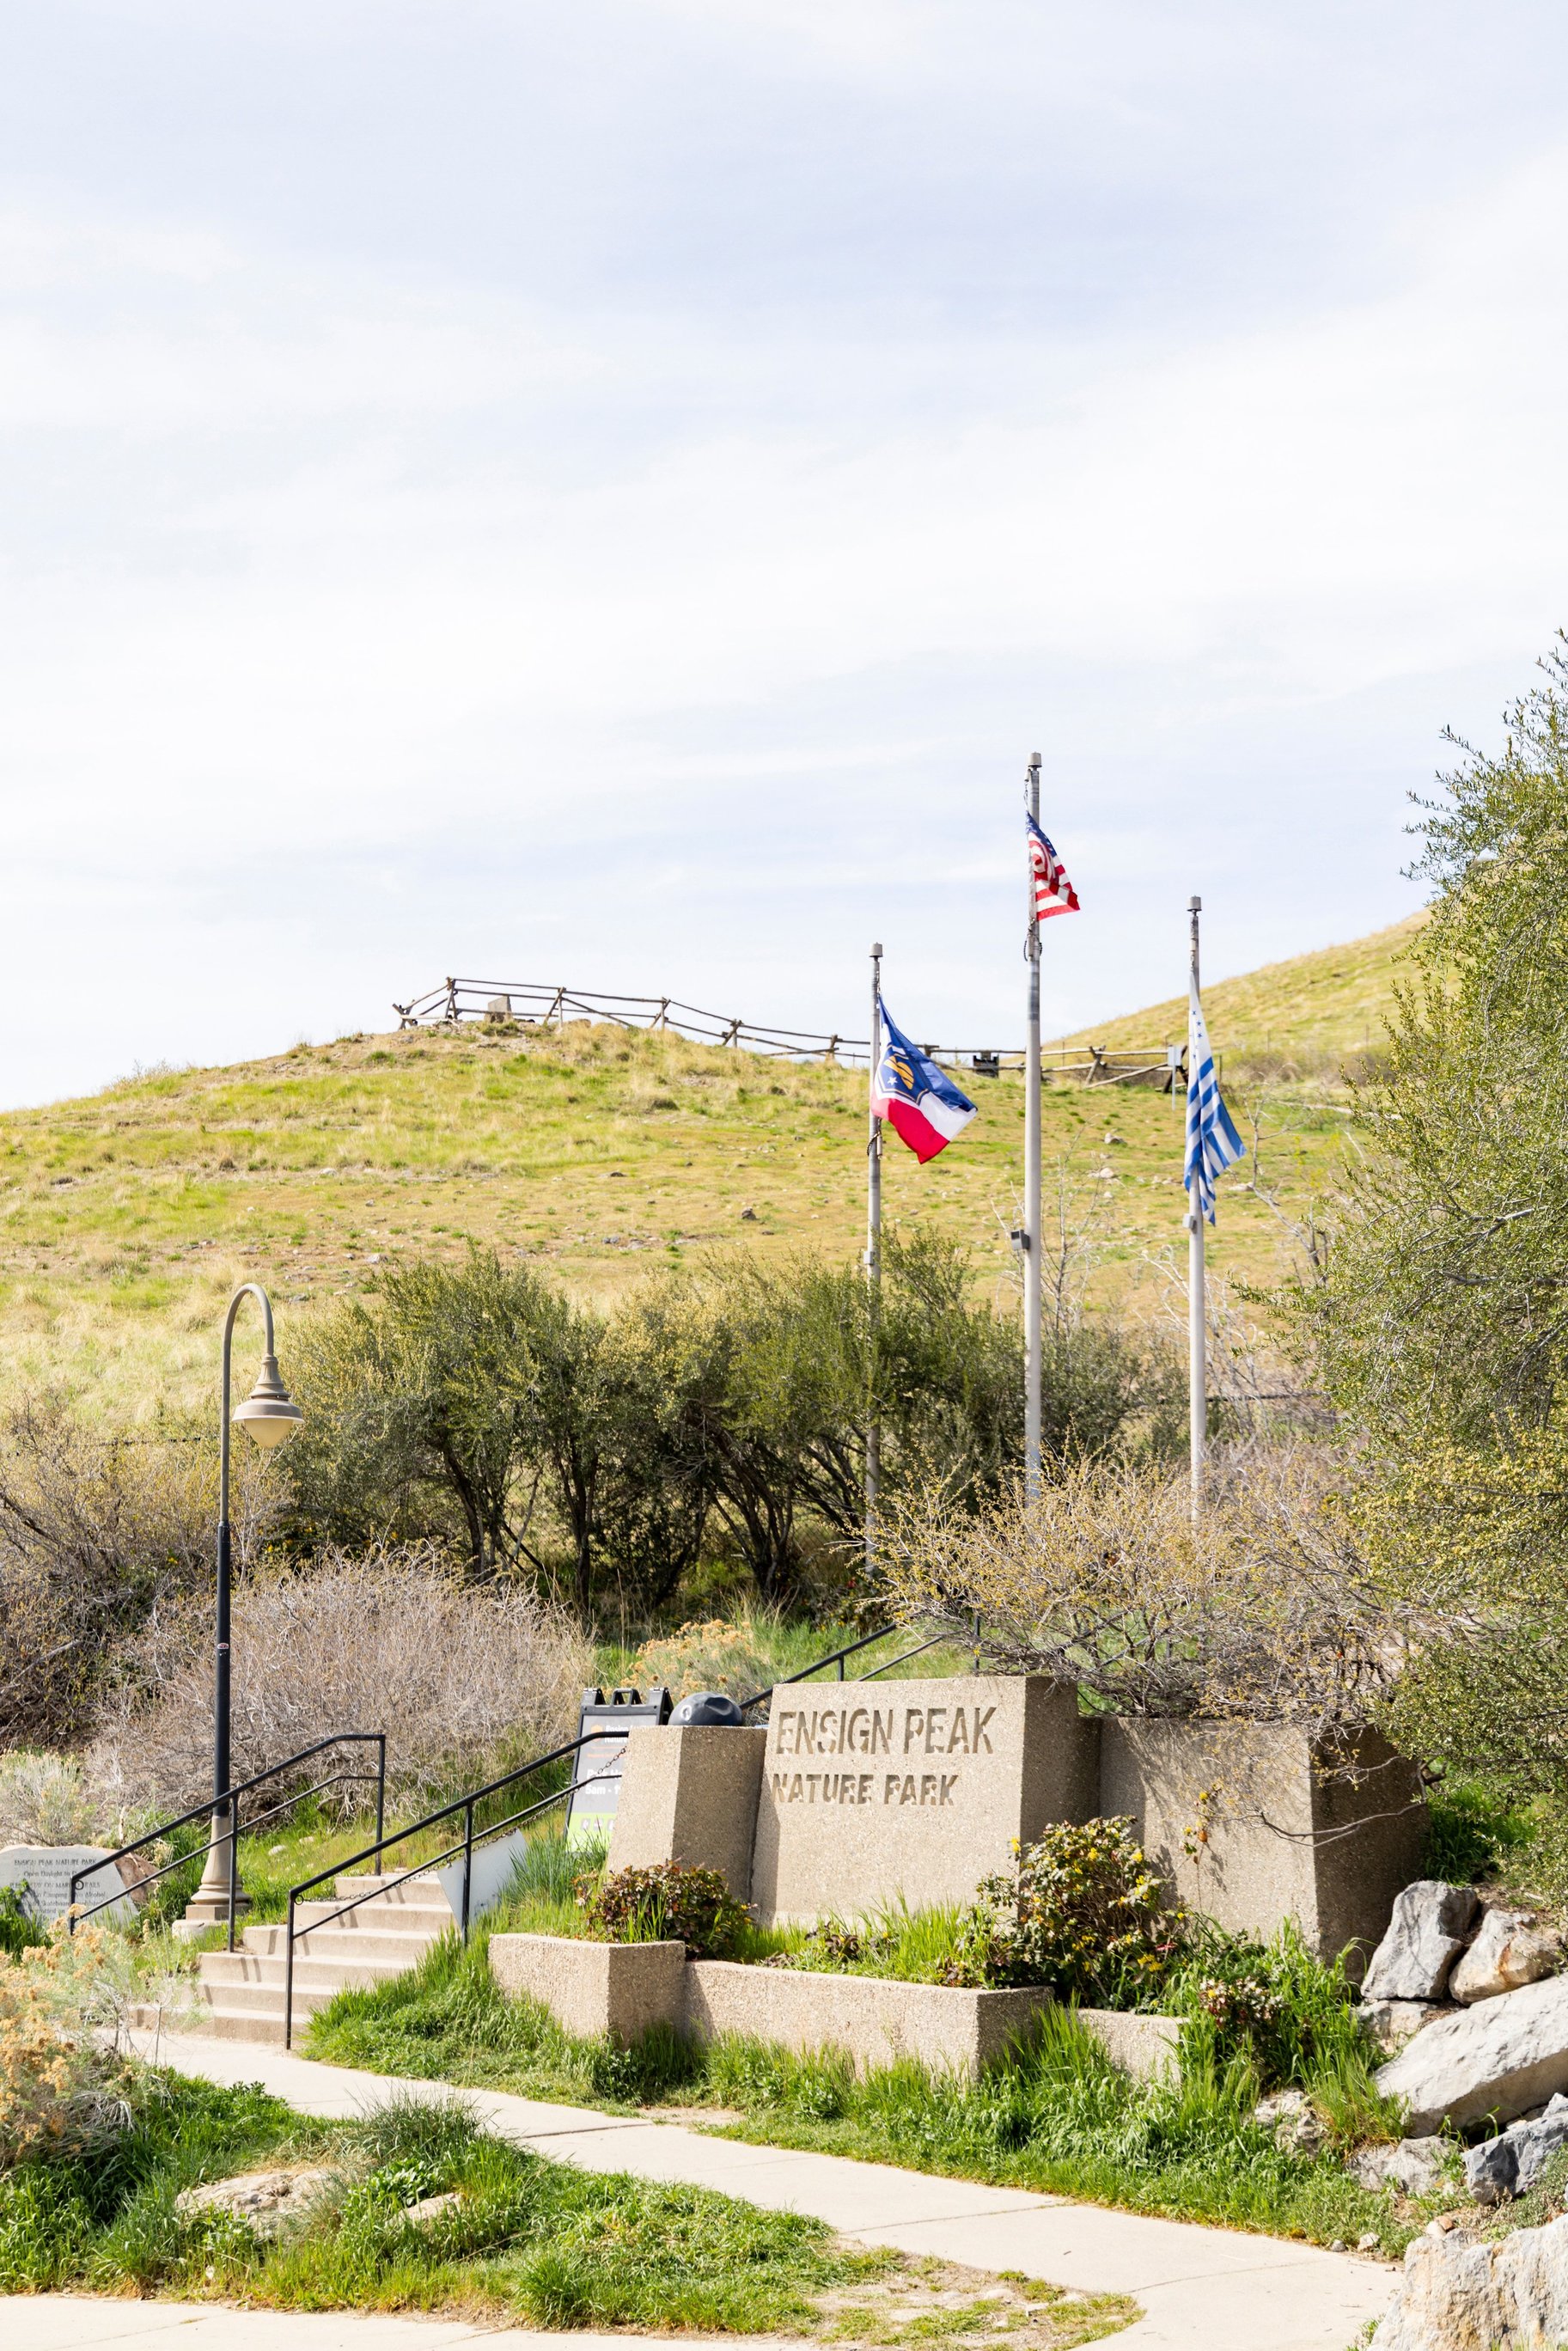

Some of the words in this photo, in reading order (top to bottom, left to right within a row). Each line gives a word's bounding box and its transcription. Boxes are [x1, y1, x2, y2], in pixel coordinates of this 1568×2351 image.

[776, 1708, 894, 1755] ENSIGN
[904, 1707, 998, 1755] PEAK
[773, 1773, 874, 1805] NATURE
[883, 1774, 959, 1806] PARK
